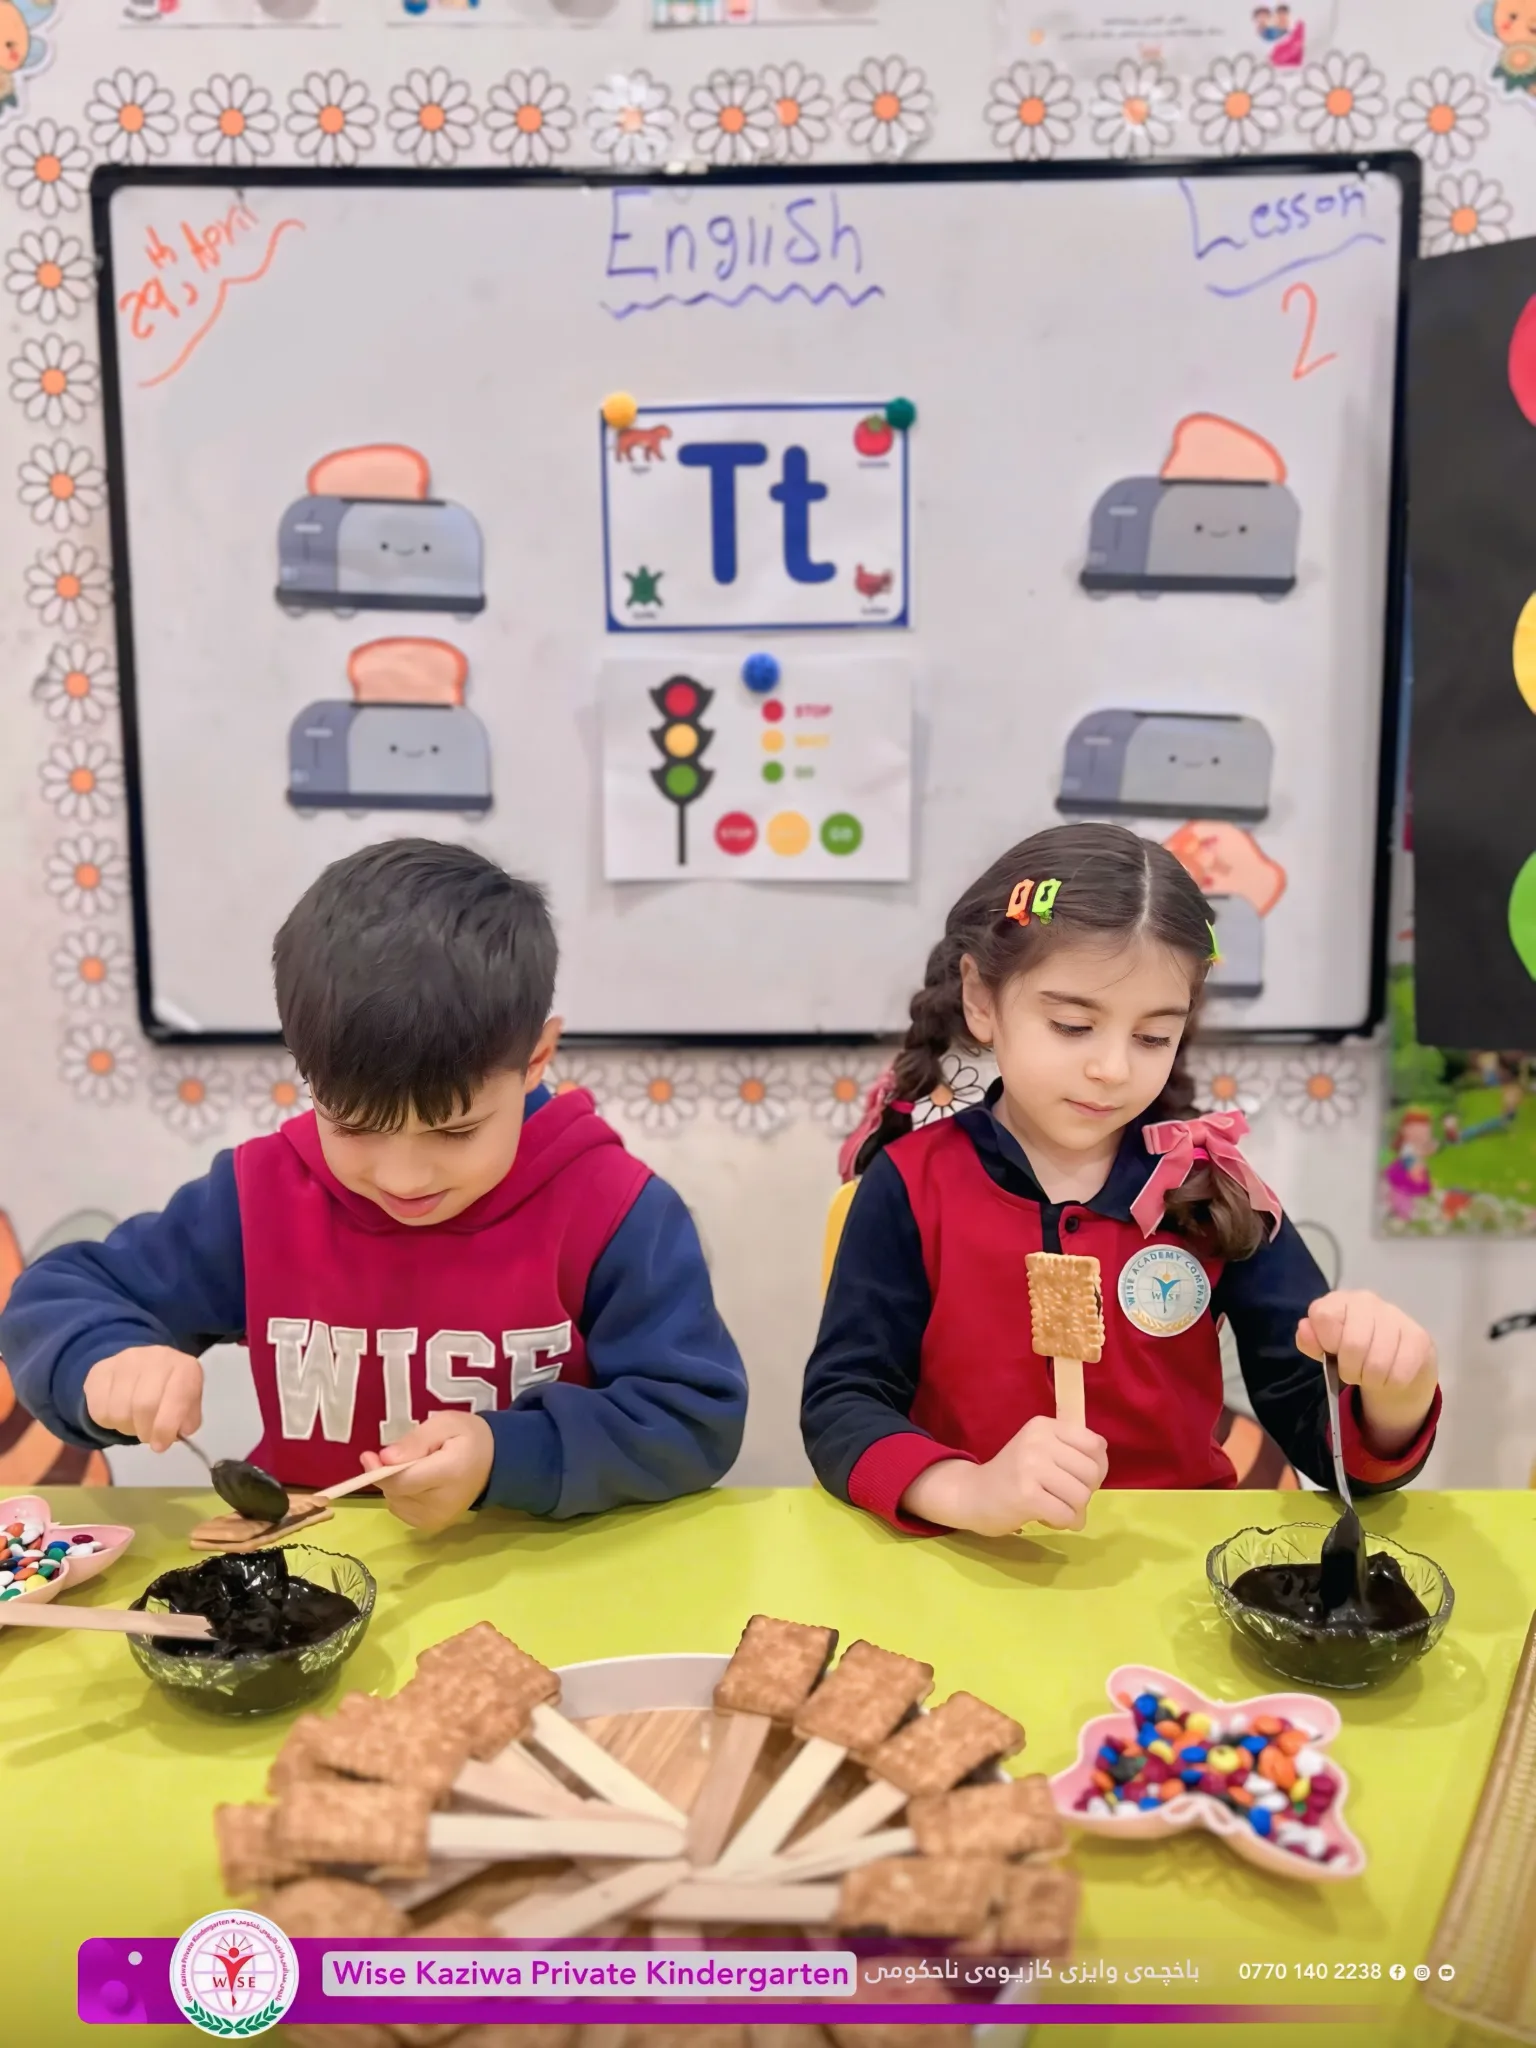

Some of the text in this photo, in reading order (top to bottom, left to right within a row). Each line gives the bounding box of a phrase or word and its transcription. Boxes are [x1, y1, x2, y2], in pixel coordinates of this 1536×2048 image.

[1178, 177, 1365, 259] Lesson
[1281, 281, 1337, 380] 2
[677, 442, 837, 585] Tt
[1132, 1251, 1181, 1275] ACADEMY
[1184, 1259, 1205, 1312] COMPANY
[266, 1317, 572, 1446] WISE
